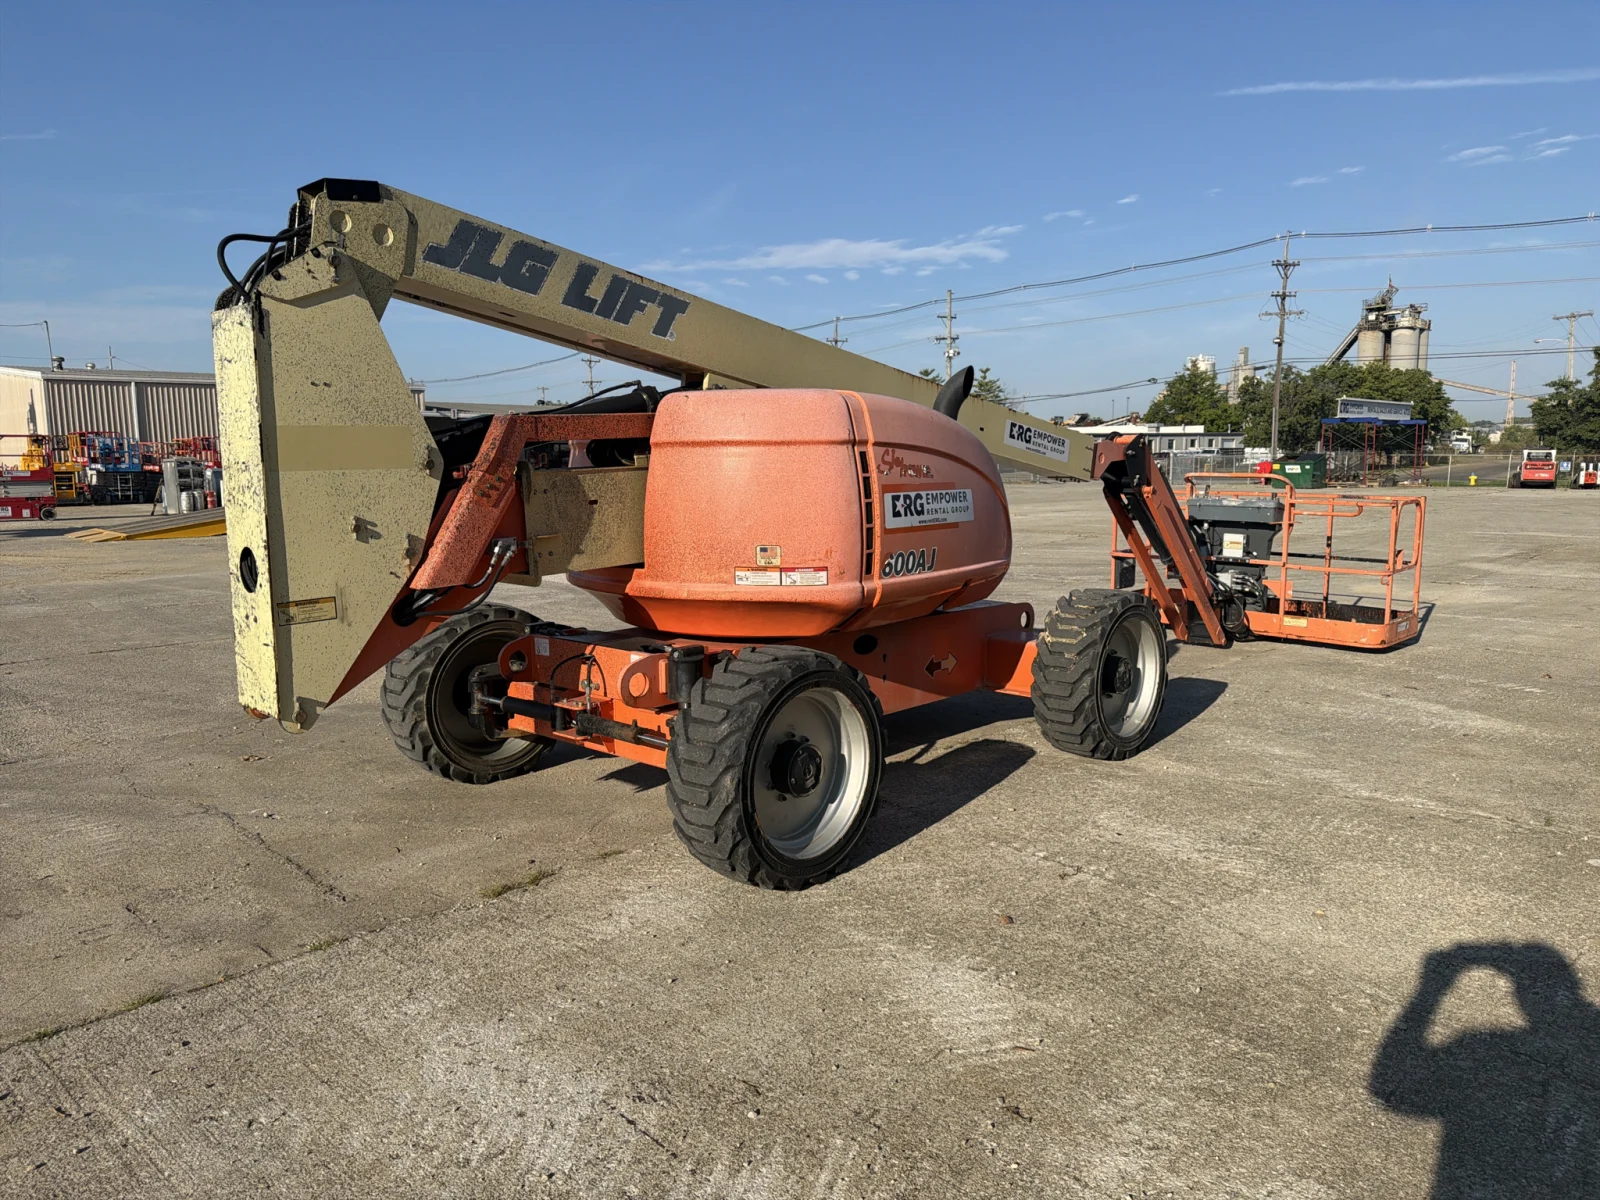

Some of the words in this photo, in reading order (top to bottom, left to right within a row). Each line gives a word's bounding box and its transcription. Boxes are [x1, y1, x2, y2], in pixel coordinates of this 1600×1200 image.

[422, 218, 559, 296] JLG
[561, 260, 691, 340] LIFT
[1009, 422, 1033, 445] ERG
[1033, 430, 1066, 448] EMPOWER
[1032, 441, 1049, 450] RENTAL
[1050, 446, 1065, 455] GROUP
[892, 492, 925, 518] ERG
[926, 491, 968, 505] EMPOWER
[926, 506, 950, 516] RENTAL
[950, 505, 970, 514] GROUP
[881, 547, 937, 579] 600AJ
